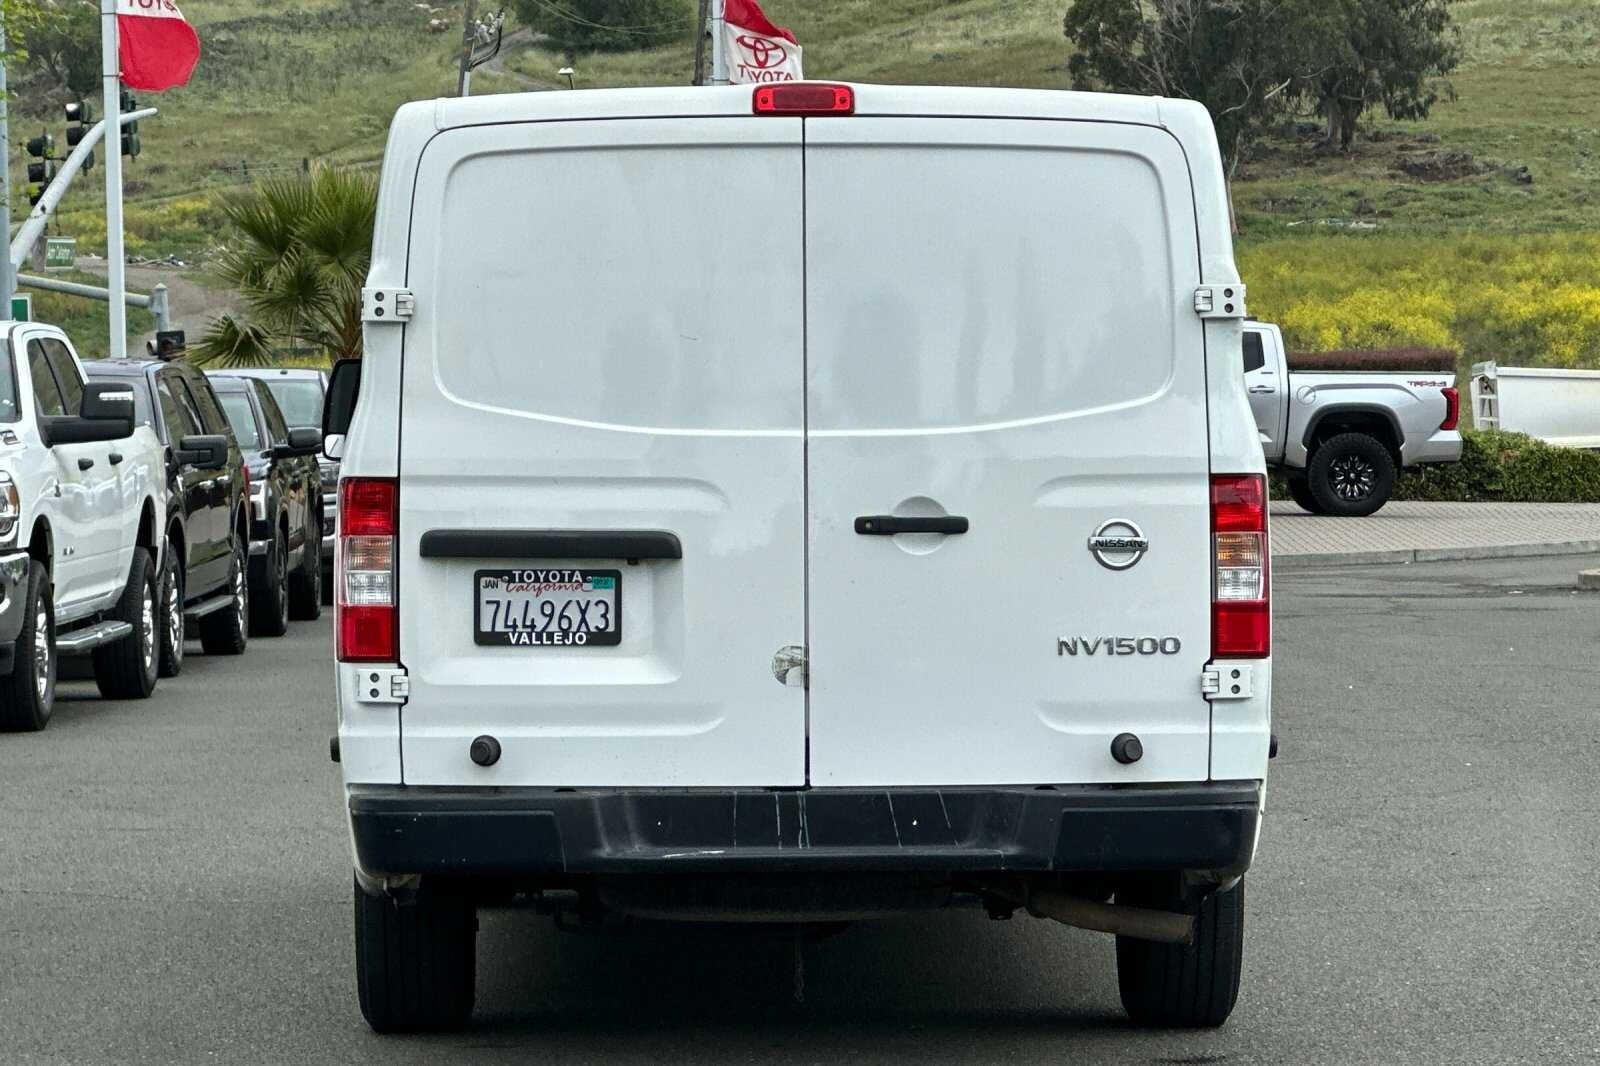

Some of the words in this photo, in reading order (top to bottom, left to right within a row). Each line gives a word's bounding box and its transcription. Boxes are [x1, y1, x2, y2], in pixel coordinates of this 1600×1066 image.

[1095, 539, 1144, 548] NISSAN
[512, 570, 583, 583] TOYOTA
[482, 579, 499, 589] JAN
[505, 581, 592, 598] California
[485, 600, 610, 632] 74496X3
[508, 632, 587, 645] VALLEJO
[1057, 635, 1182, 656] NV1500
